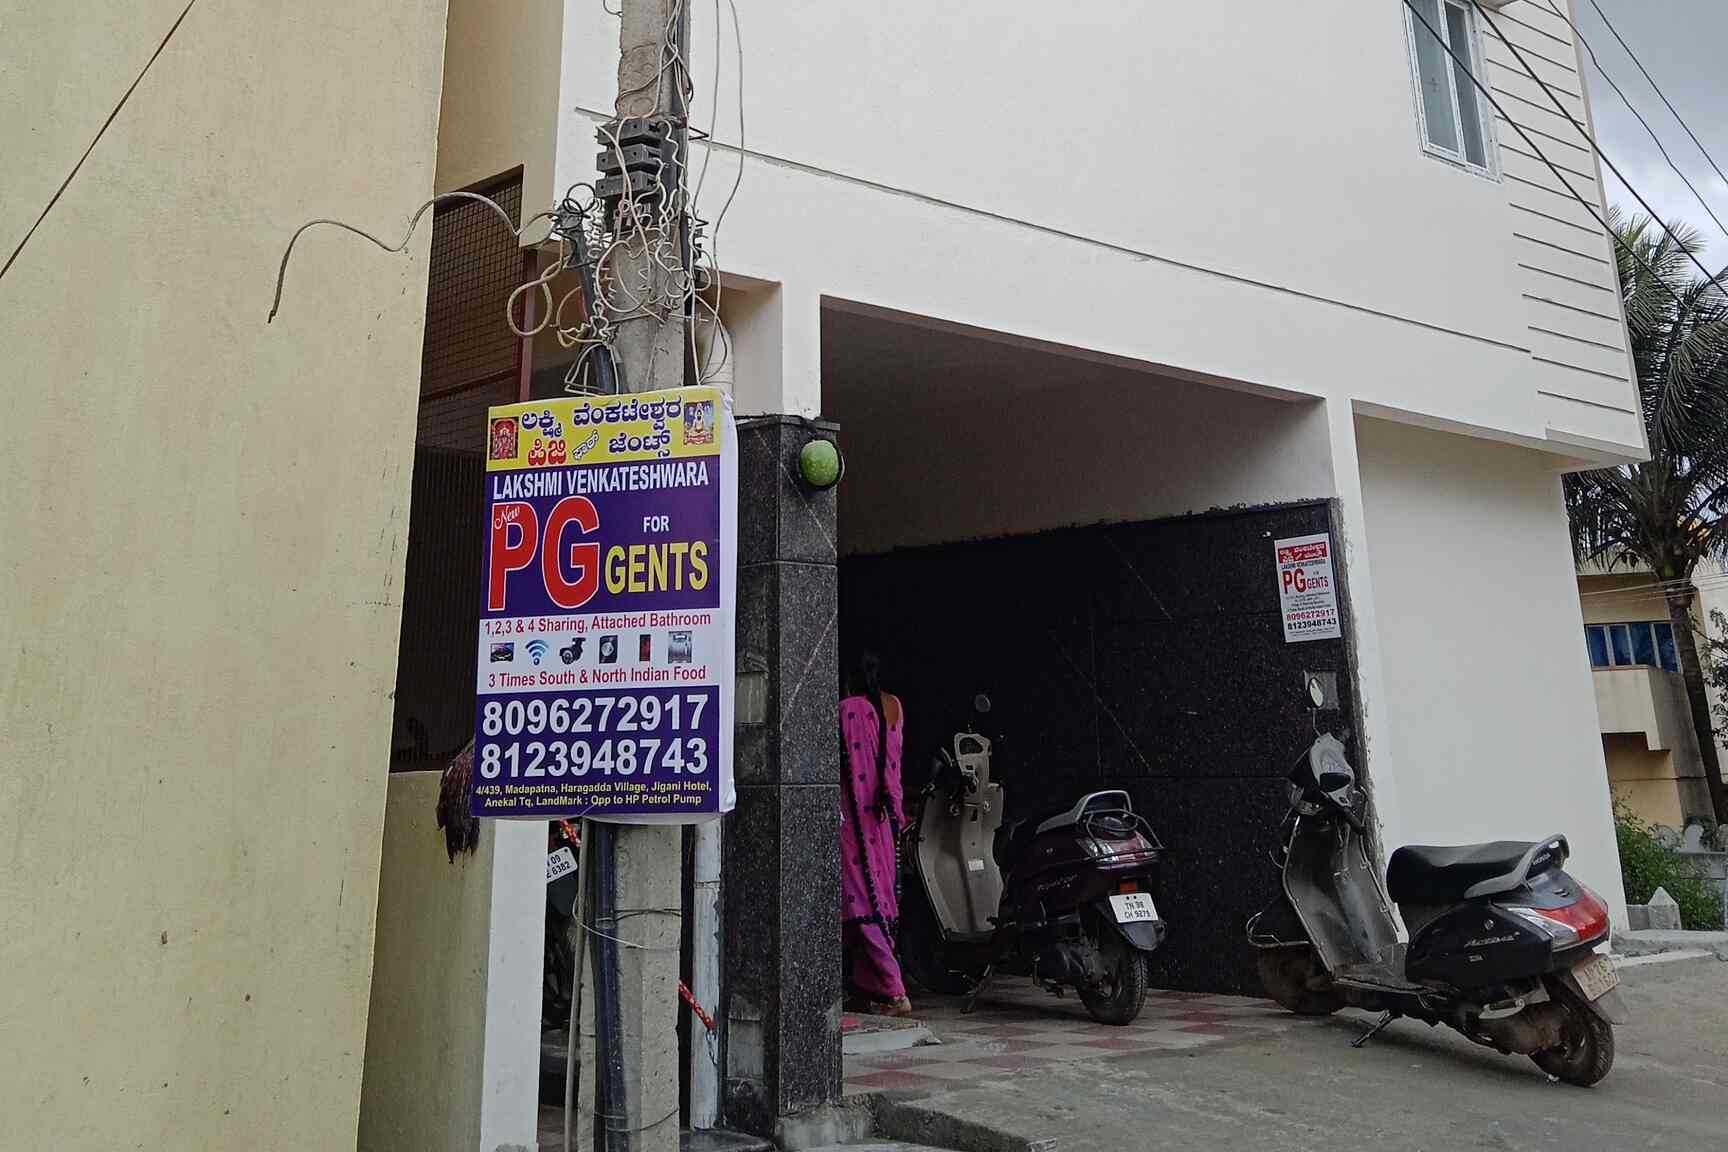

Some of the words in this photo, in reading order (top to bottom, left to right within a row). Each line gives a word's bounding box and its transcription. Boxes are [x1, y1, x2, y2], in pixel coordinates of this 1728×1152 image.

[573, 395, 682, 431] ವೆಂಕಟೇಶ್ವರ
[493, 470, 562, 499] LAKSHMI
[566, 461, 709, 495] VENKATESHWARA
[494, 505, 520, 530] New
[643, 515, 670, 533] FOR
[488, 495, 600, 612] PG
[605, 540, 709, 595] GENTS
[1282, 568, 1306, 594] PG
[1307, 575, 1329, 589] GENTS
[485, 620, 512, 636] 1,2,3
[516, 620, 524, 633] &
[528, 620, 534, 633] 4
[538, 617, 588, 634] Sharing,
[592, 614, 646, 630] Attached
[650, 613, 711, 628] Bathroom
[488, 674, 496, 688] 3
[499, 672, 536, 688] Times
[539, 670, 576, 686] South
[579, 670, 588, 683] &
[592, 668, 627, 683] North
[631, 667, 669, 682] Indian
[673, 665, 707, 681] Food
[482, 694, 709, 736] 8096272917
[480, 737, 708, 779] 8123948743
[560, 783, 612, 795] Haragadda
[614, 781, 649, 793] Village,
[651, 780, 681, 793] Jigani
[484, 797, 517, 808] Anekal
[536, 795, 583, 806] LandMark
[591, 795, 611, 807] Opp
[613, 795, 624, 804] to
[625, 794, 640, 804] HP
[642, 794, 671, 804] Petrol
[673, 794, 702, 805] Pump
